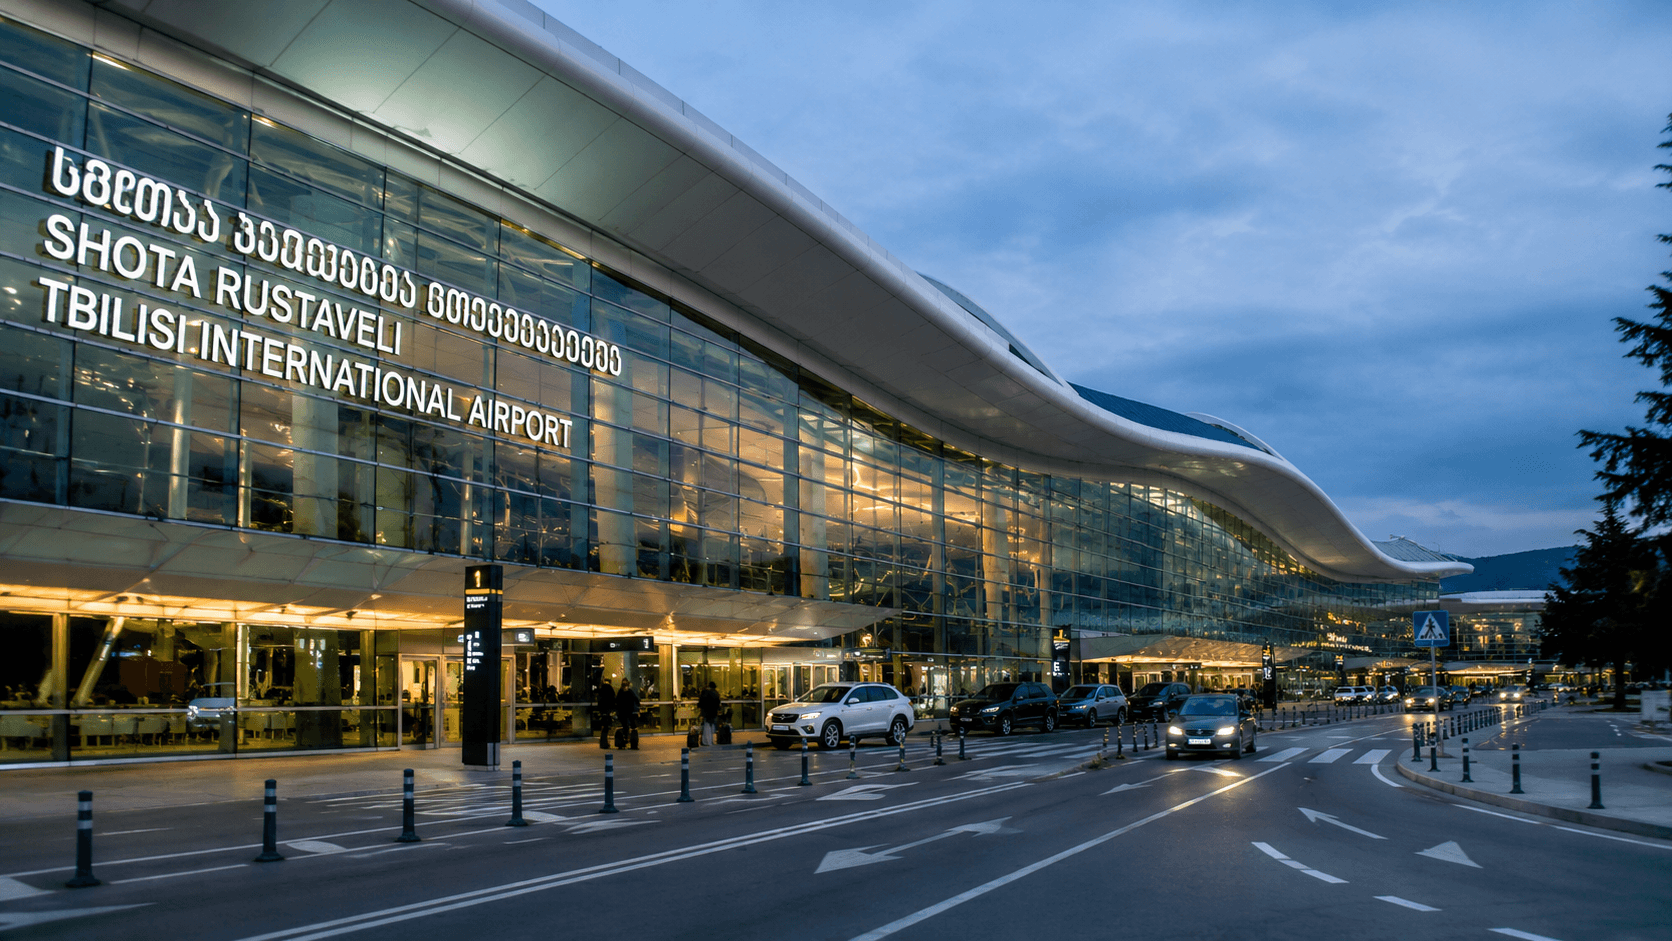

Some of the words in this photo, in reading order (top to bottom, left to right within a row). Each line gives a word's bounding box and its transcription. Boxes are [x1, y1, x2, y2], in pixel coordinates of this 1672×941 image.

[44, 214, 202, 299] SHOTA
[216, 267, 402, 356] RUSTAVELI
[39, 276, 187, 352] TBILISI
[200, 321, 461, 423] INTERNATIONAL
[468, 395, 574, 448] AIRPORT
[474, 570, 481, 588] 1
